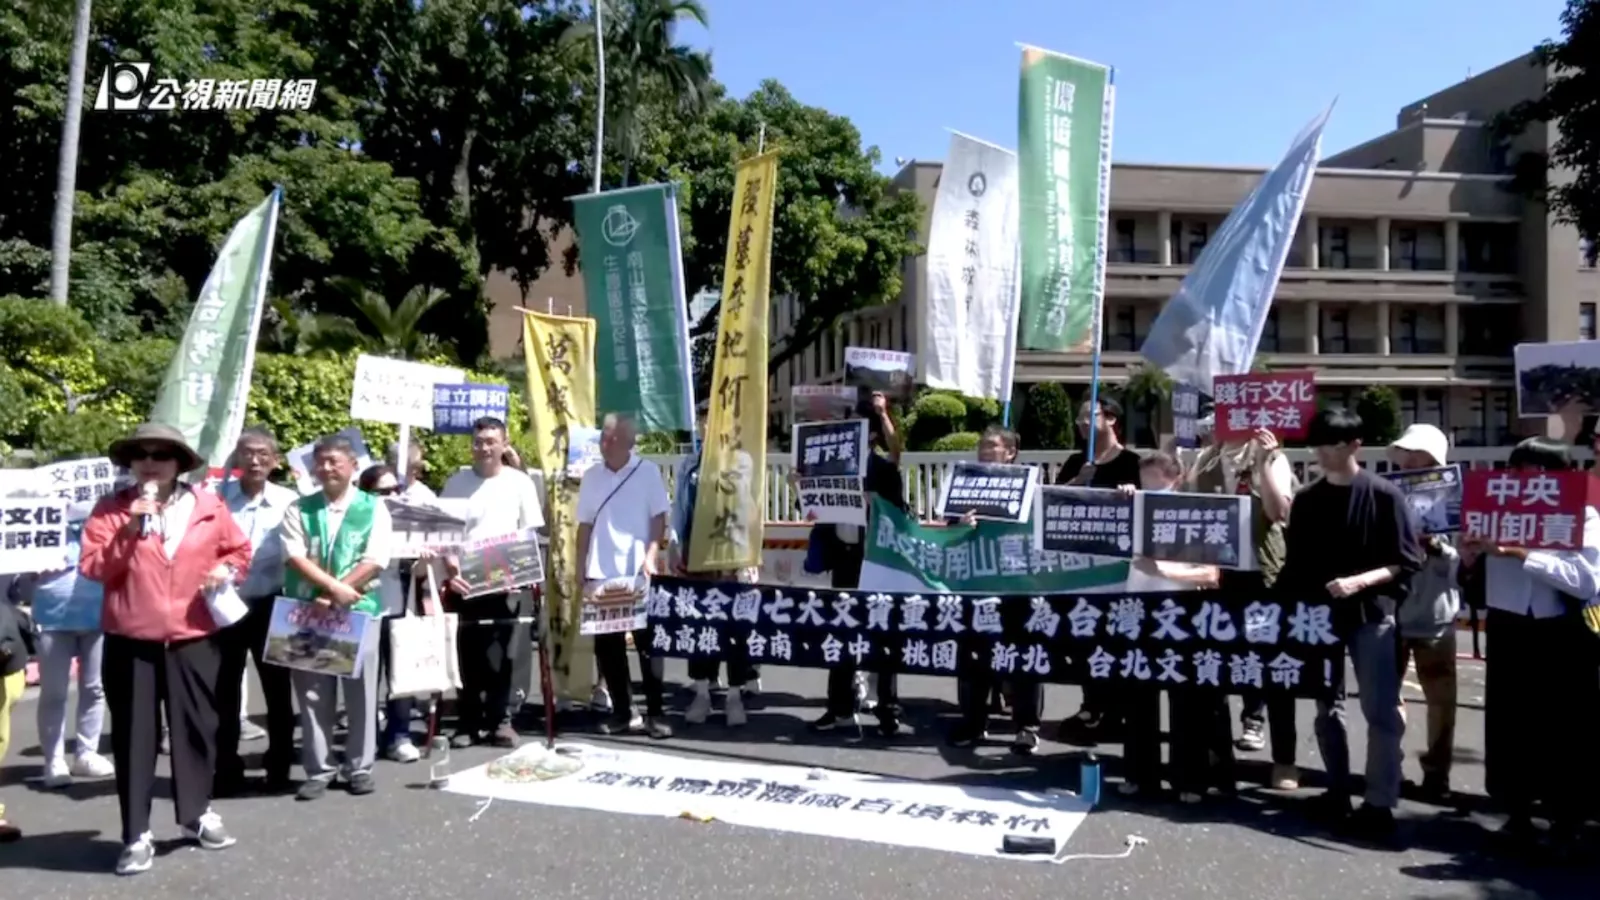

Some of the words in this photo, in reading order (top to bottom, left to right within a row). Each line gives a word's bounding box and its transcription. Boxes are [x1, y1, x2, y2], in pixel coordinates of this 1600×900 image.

[434, 388, 506, 406] 建立調和
[1215, 380, 1313, 404] 踐行文化
[1228, 406, 1300, 430] 基本法
[1486, 473, 1560, 506] 中央
[0, 507, 62, 525] 文化
[0, 530, 61, 550] 評估
[1465, 511, 1576, 546] 別卸責
[649, 585, 1003, 634] 搶救全國七大文資重災區
[1024, 596, 1340, 645] 為台灣文化留根
